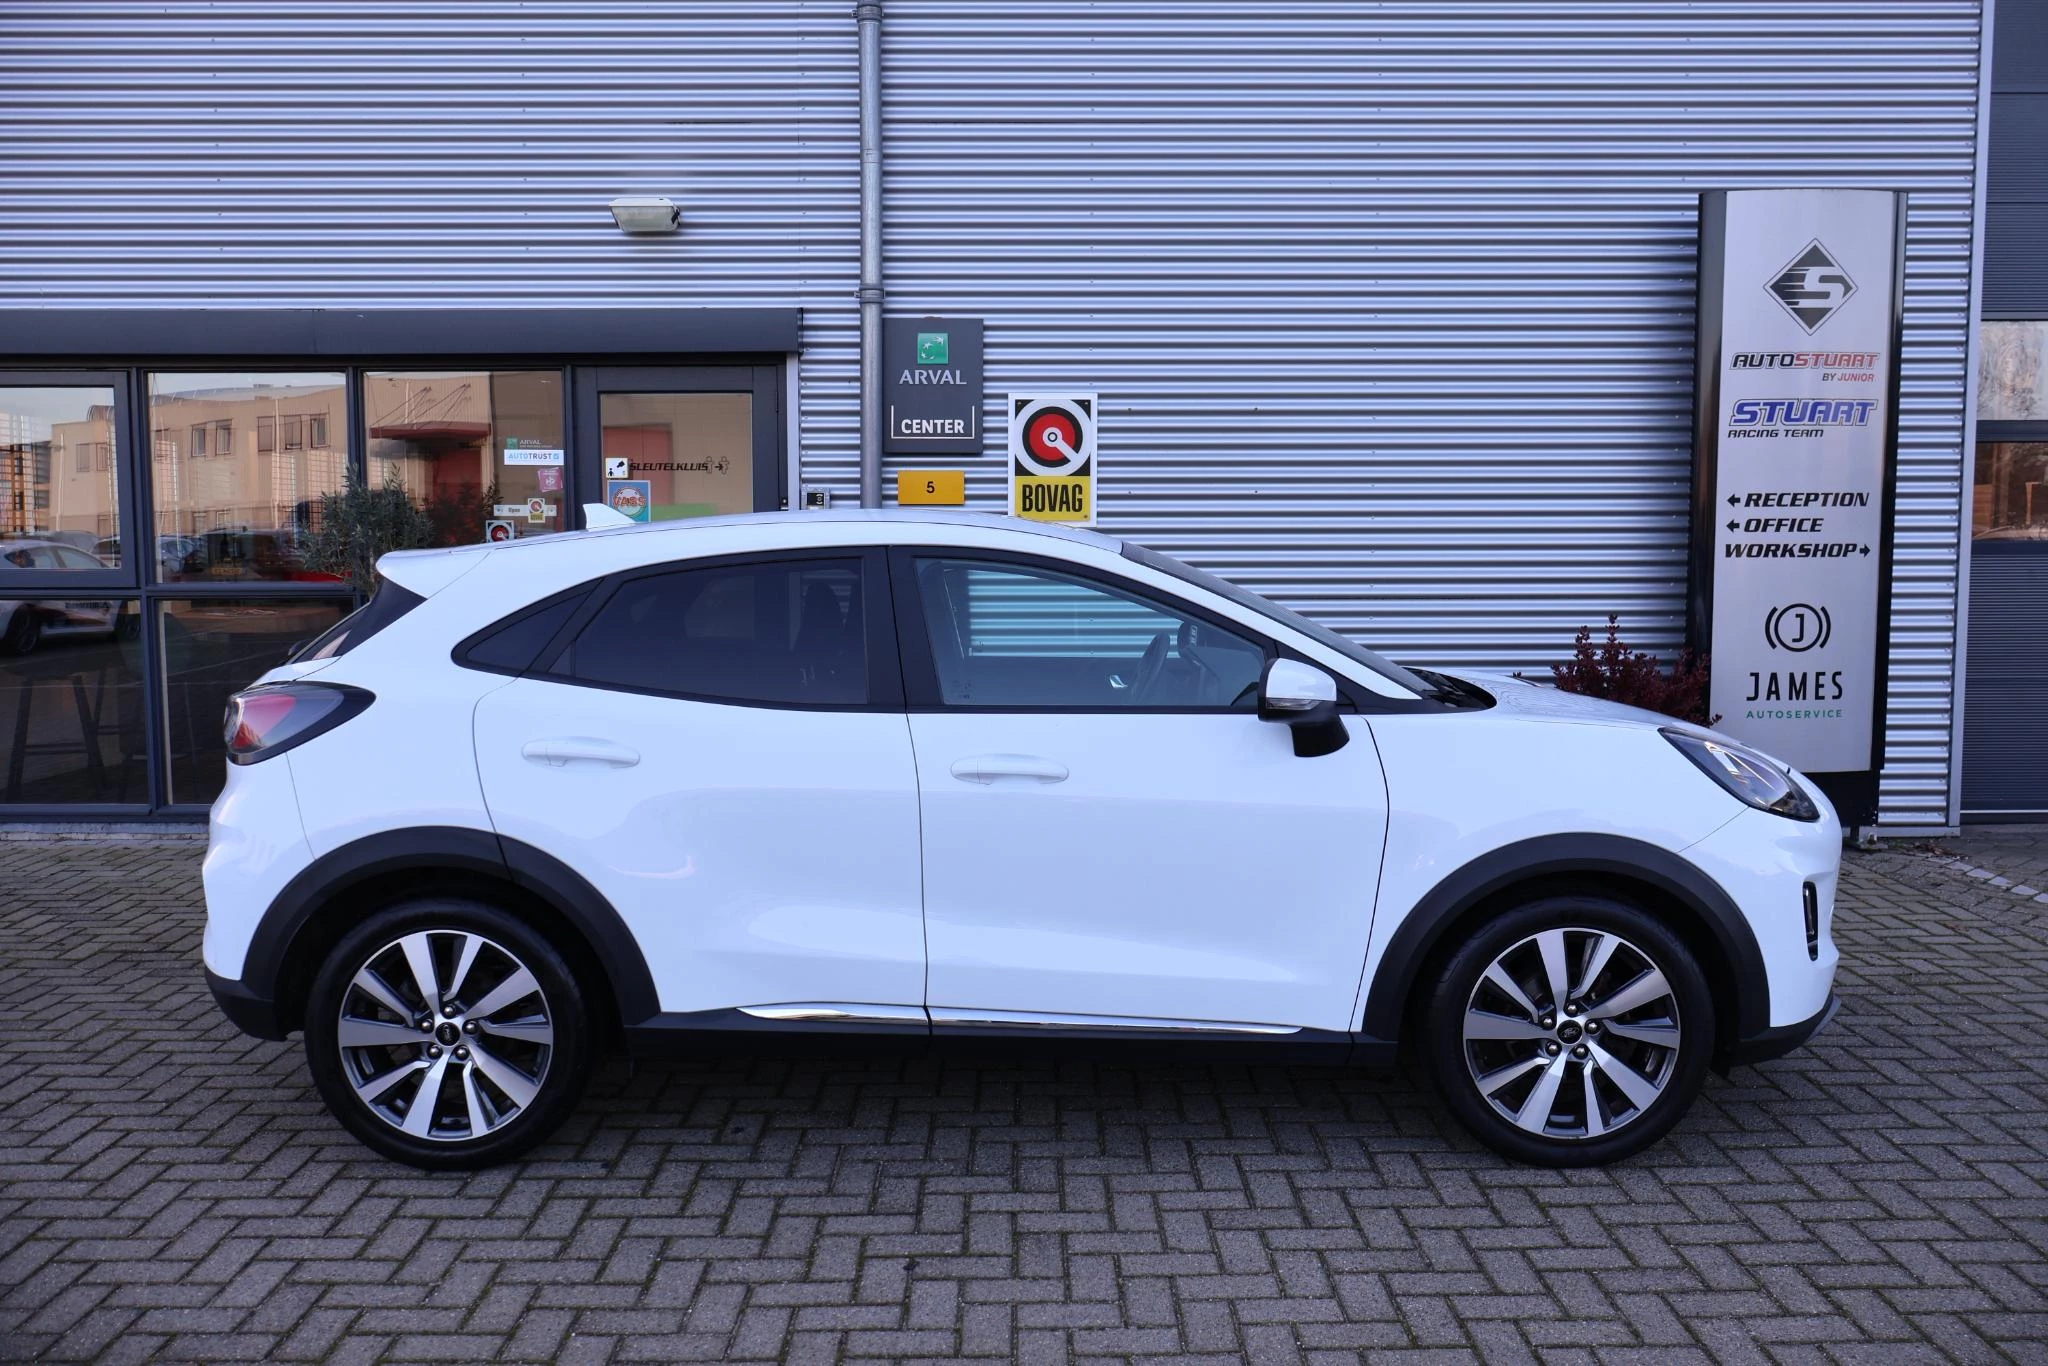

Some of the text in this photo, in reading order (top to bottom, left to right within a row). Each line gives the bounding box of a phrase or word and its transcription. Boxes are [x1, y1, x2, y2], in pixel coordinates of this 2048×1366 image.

[1731, 353, 1879, 369] AUTOSTUART
[899, 370, 967, 385] ARVAL
[1822, 373, 1874, 382] BY JUNIOR
[1729, 399, 1879, 426] STUART
[901, 419, 965, 434] CENTER
[1727, 429, 1823, 438] RACING TEAM
[629, 462, 709, 471] SLEUTELKLUIS
[926, 481, 935, 493] 5
[1022, 484, 1083, 512] BOVAG
[1744, 492, 1869, 507] RECEPTION
[1744, 518, 1824, 533] OFFICE
[1725, 543, 1857, 558] WORKSHOP
[1746, 671, 1843, 702] JAMES
[1746, 709, 1843, 719] AUTOSERVICE
